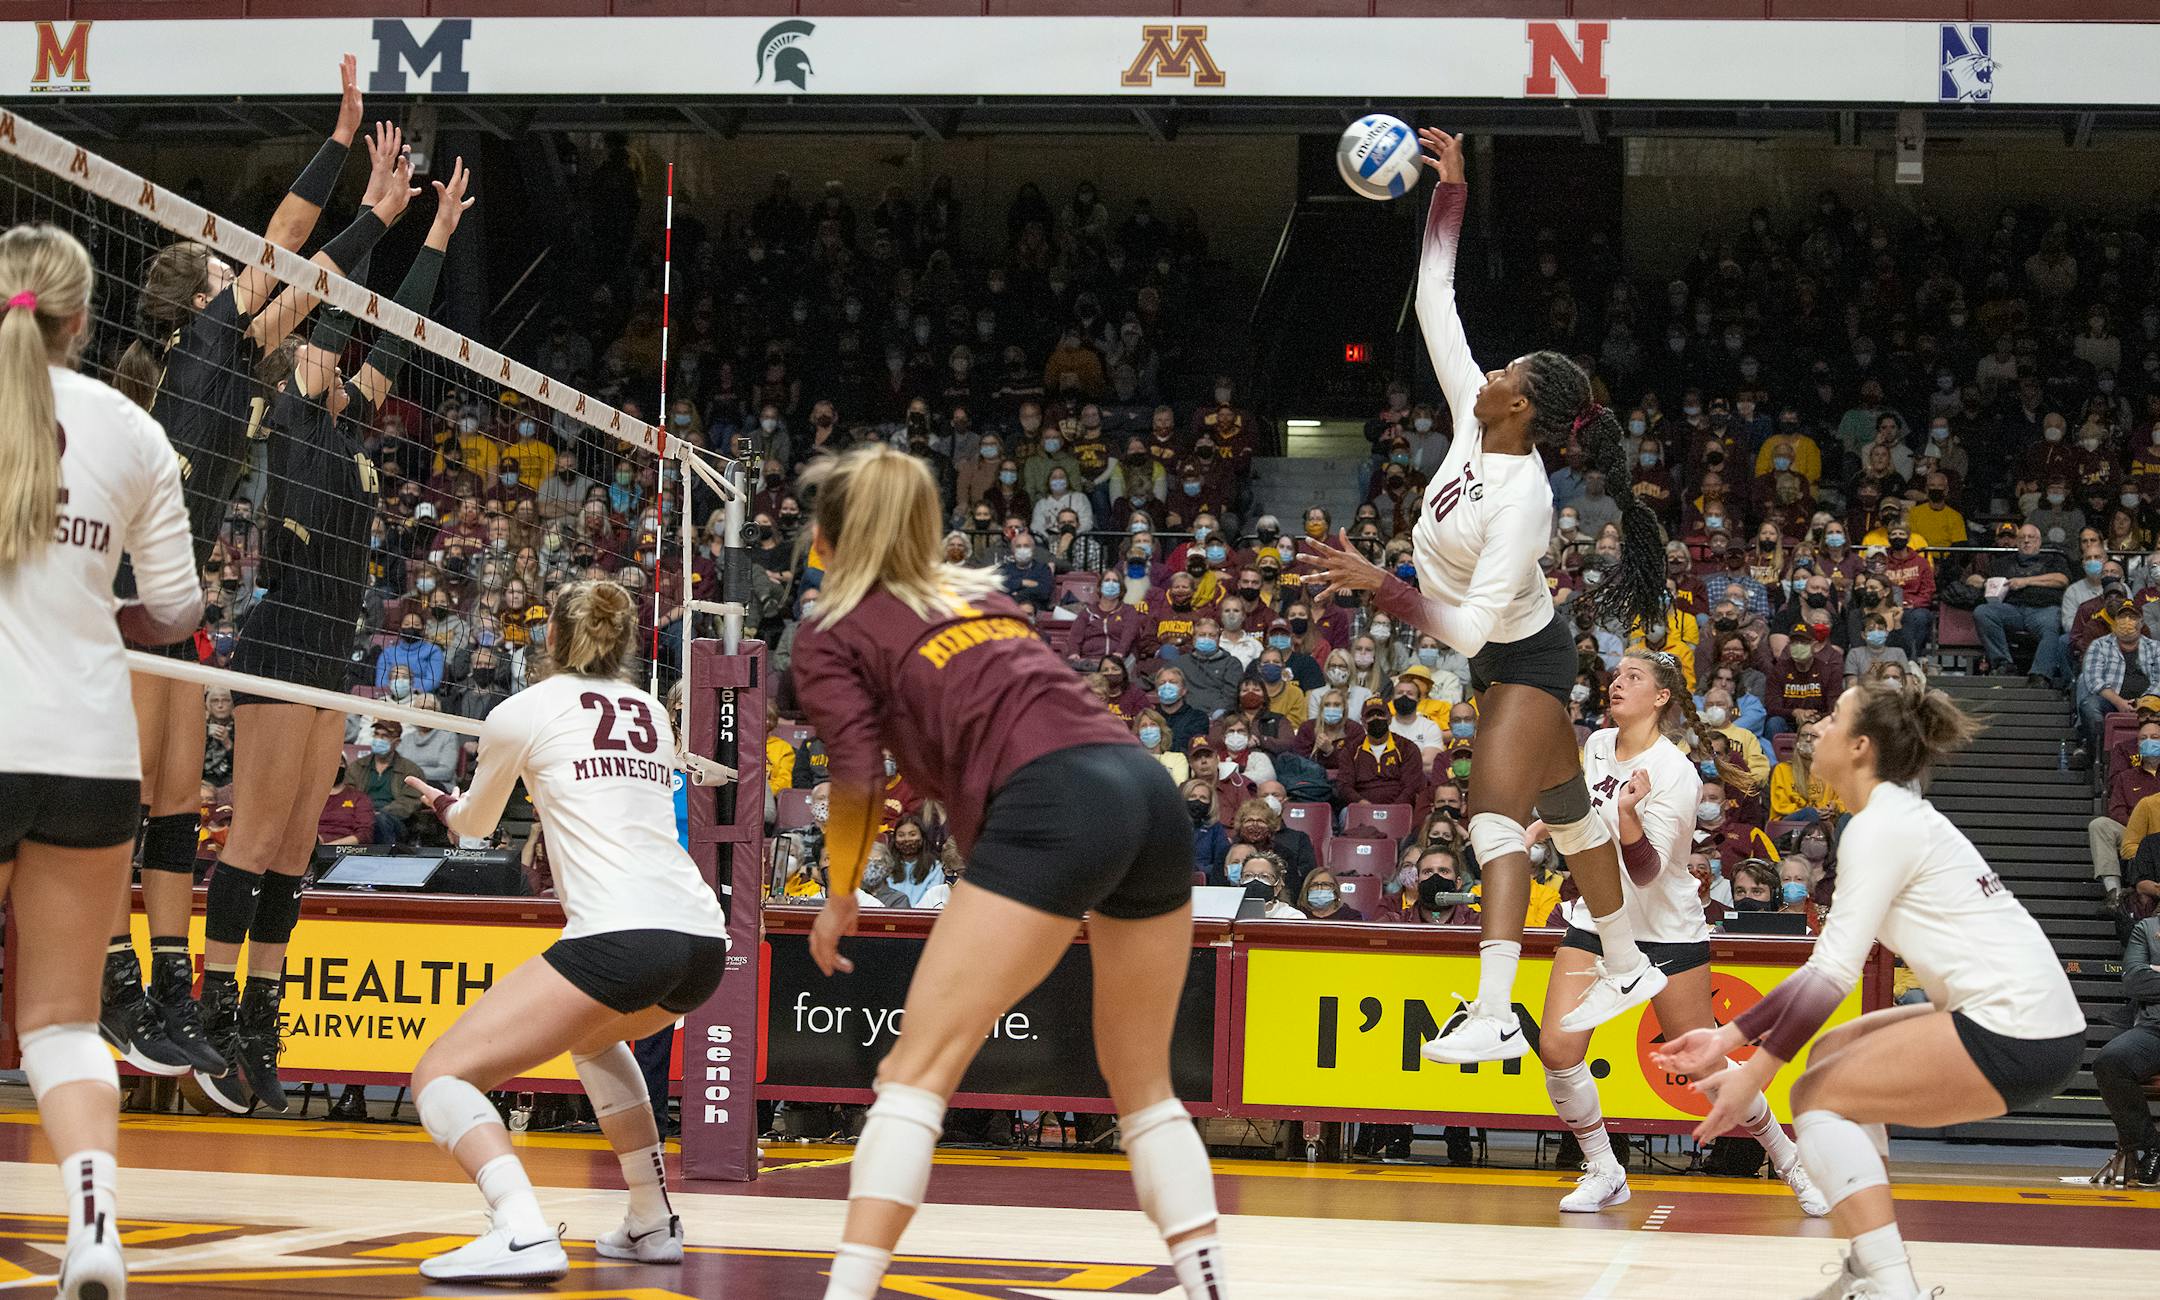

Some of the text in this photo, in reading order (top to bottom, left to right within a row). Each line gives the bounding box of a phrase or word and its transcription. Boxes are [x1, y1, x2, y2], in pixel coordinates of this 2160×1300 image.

[31, 20, 92, 82] M
[369, 19, 471, 92] M
[1120, 25, 1226, 87] M
[1524, 20, 1610, 98] N
[1429, 476, 1461, 523] 10
[580, 692, 658, 753] 23
[573, 756, 671, 788] MINNESOTA
[1592, 775, 1619, 800] M
[279, 956, 494, 1005] HEALTH
[277, 1012, 427, 1040] FAIRVIEW
[793, 991, 852, 1033] for
[862, 1007, 907, 1047] yo
[704, 1025, 733, 1124] senoh
[1665, 1073, 1689, 1085] LO
